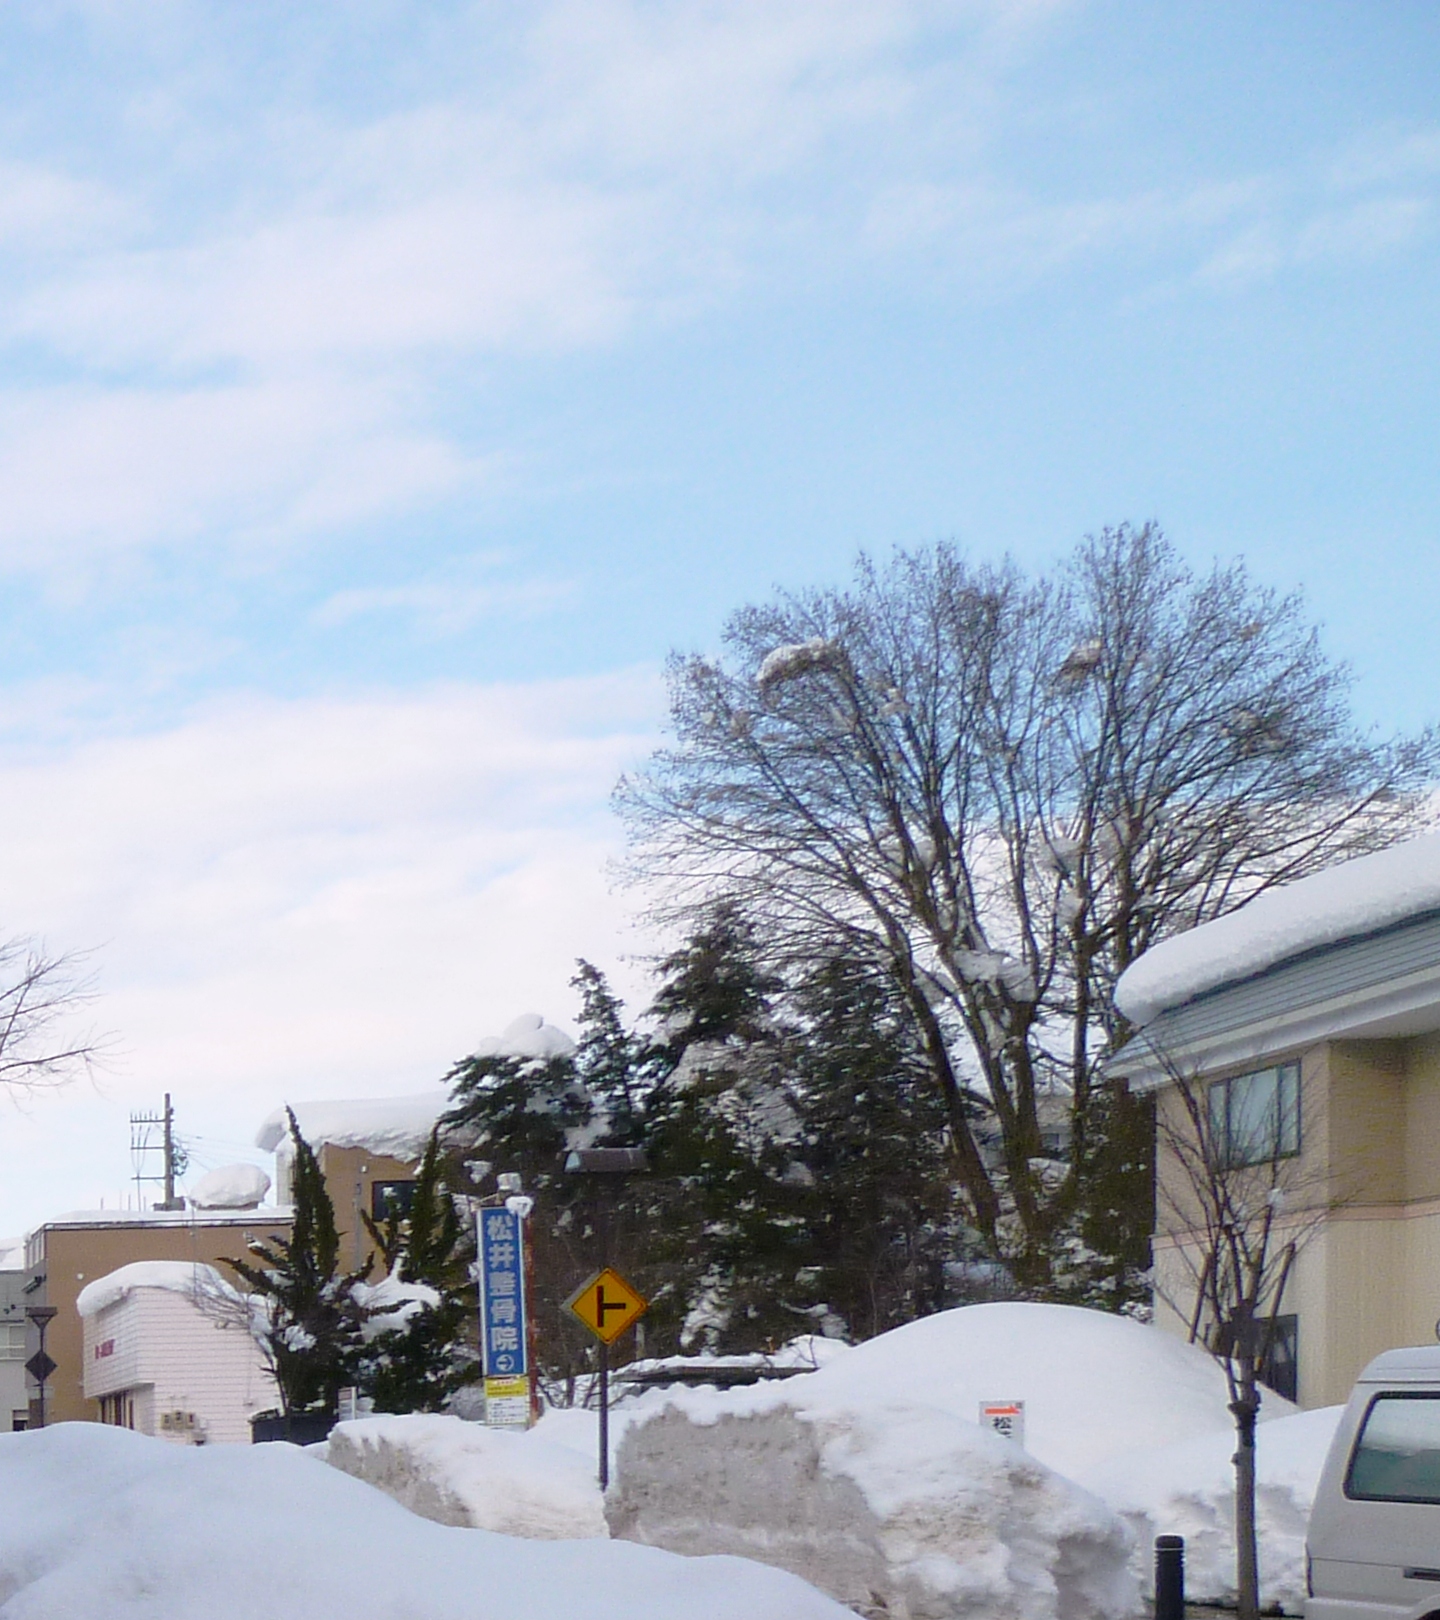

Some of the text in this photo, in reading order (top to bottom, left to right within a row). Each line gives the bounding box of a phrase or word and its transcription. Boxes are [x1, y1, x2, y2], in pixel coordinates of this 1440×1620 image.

[487, 1214, 518, 1351] 松井整骨院
